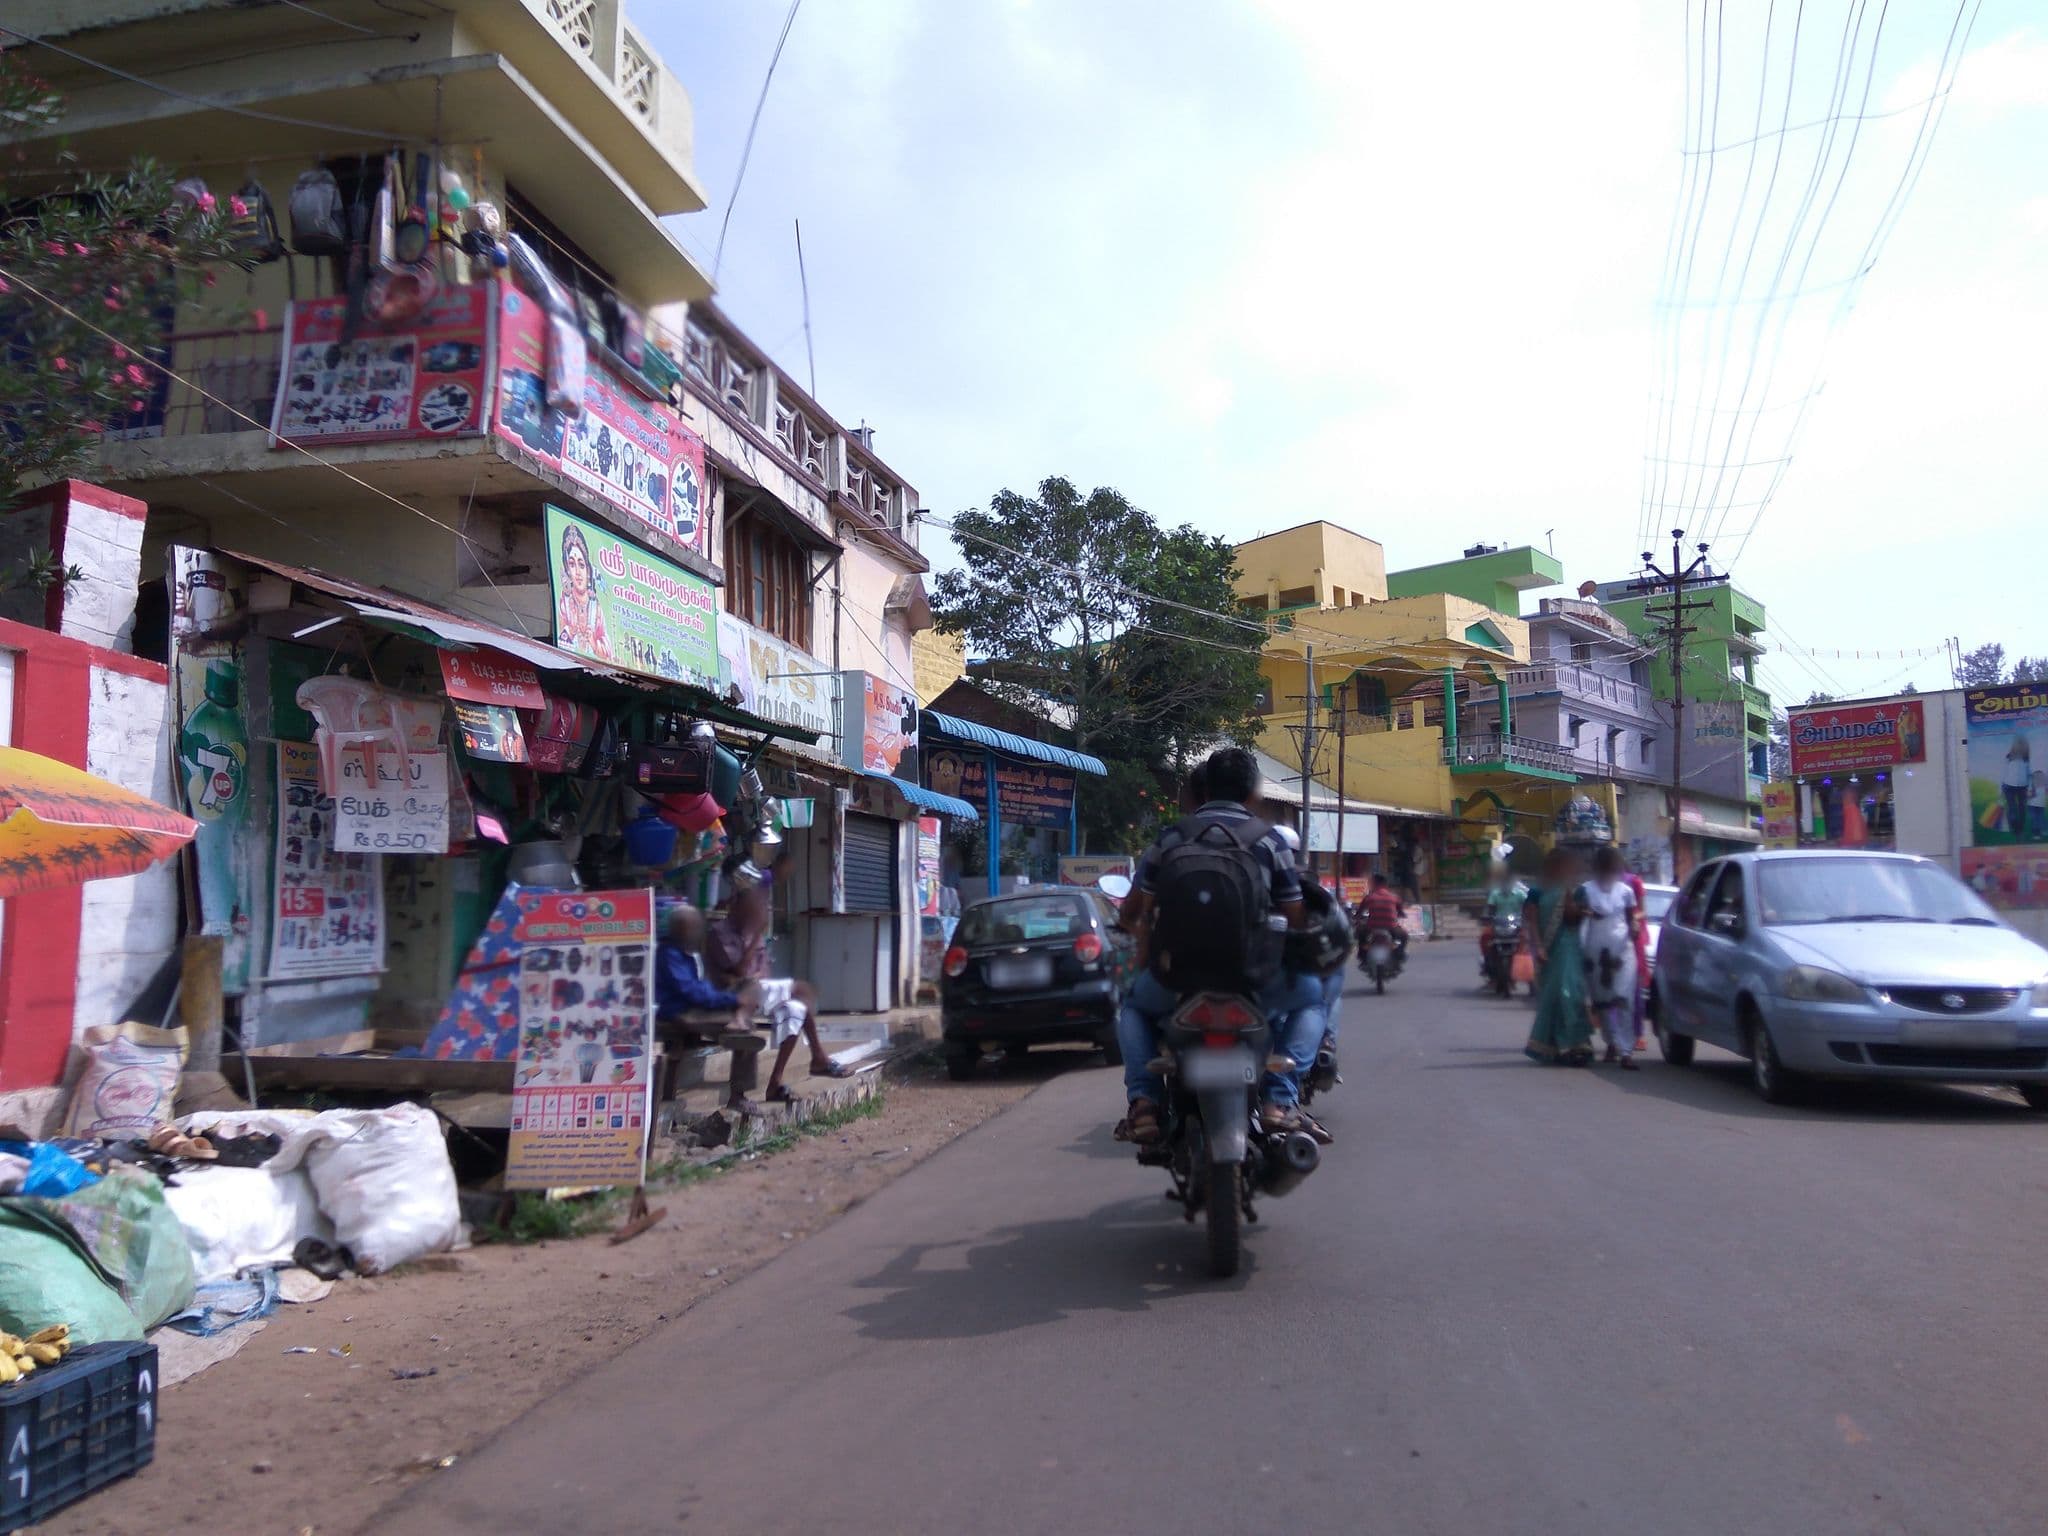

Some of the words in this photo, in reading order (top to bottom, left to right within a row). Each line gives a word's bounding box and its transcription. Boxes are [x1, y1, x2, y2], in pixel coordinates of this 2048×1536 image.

[628, 560, 714, 615] பாலமுருகன்
[491, 681, 525, 697] 3G/4G
[506, 670, 538, 684] 1.5GB
[1795, 713, 1897, 745] அம்மன்
